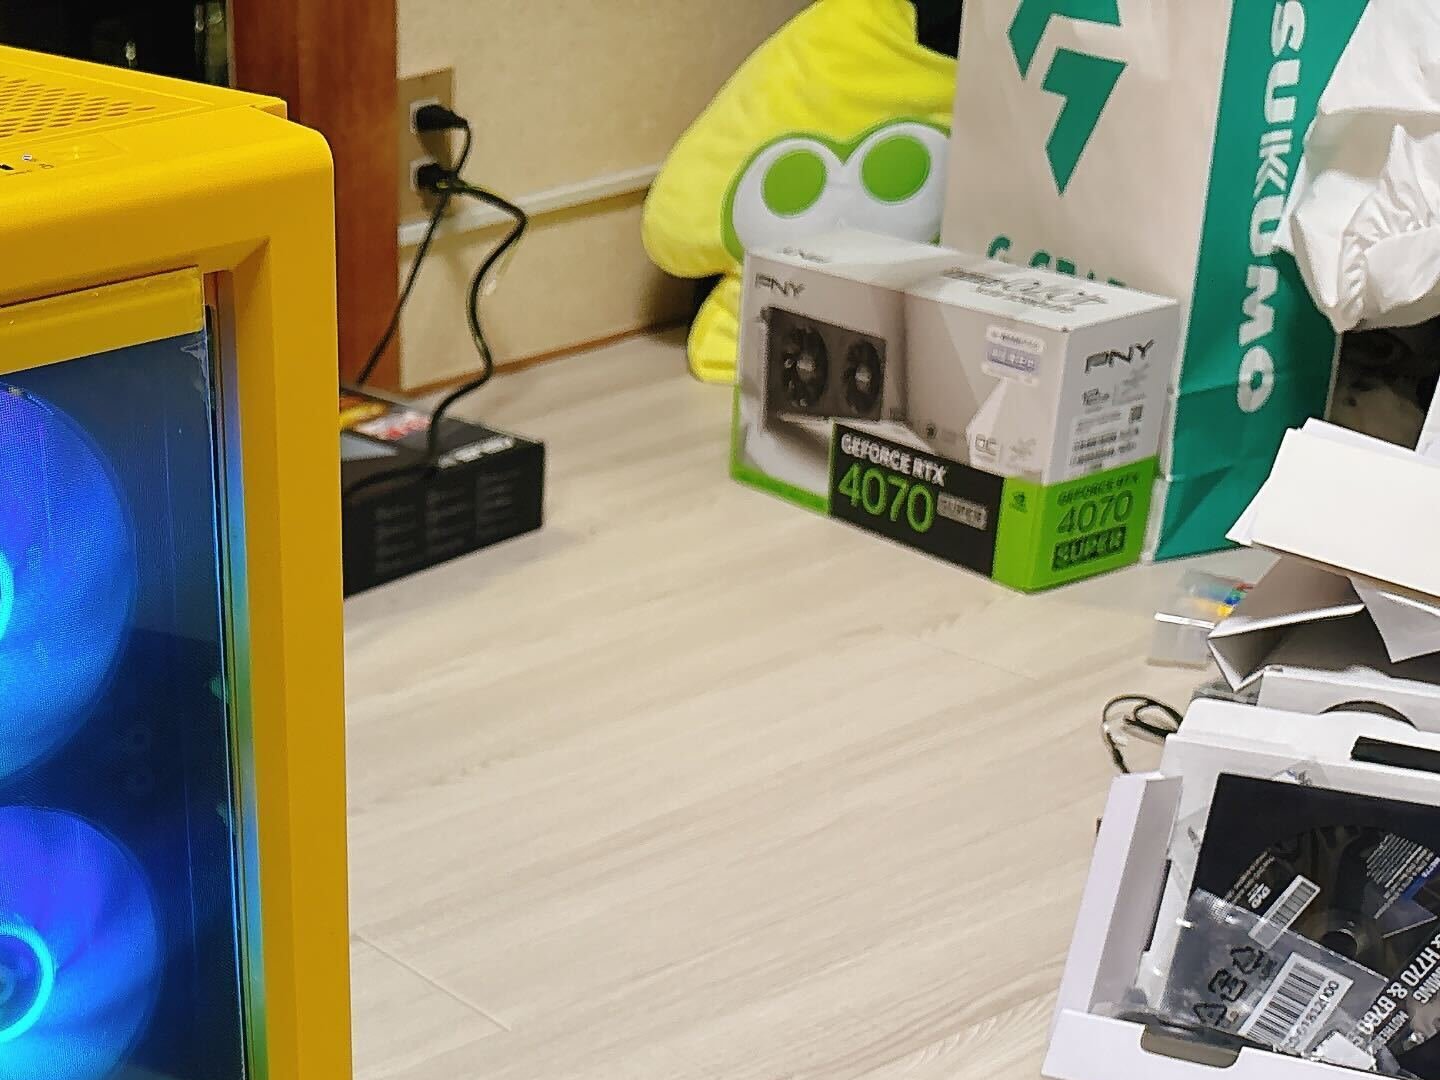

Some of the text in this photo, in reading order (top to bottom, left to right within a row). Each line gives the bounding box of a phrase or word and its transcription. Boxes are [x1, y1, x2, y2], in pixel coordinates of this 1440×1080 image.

[1085, 339, 1155, 374] PNY
[841, 432, 948, 487] GEFORCE RTX
[838, 462, 935, 534] 4070
[1056, 490, 1134, 533] 4070
[1400, 946, 1440, 987] H770
